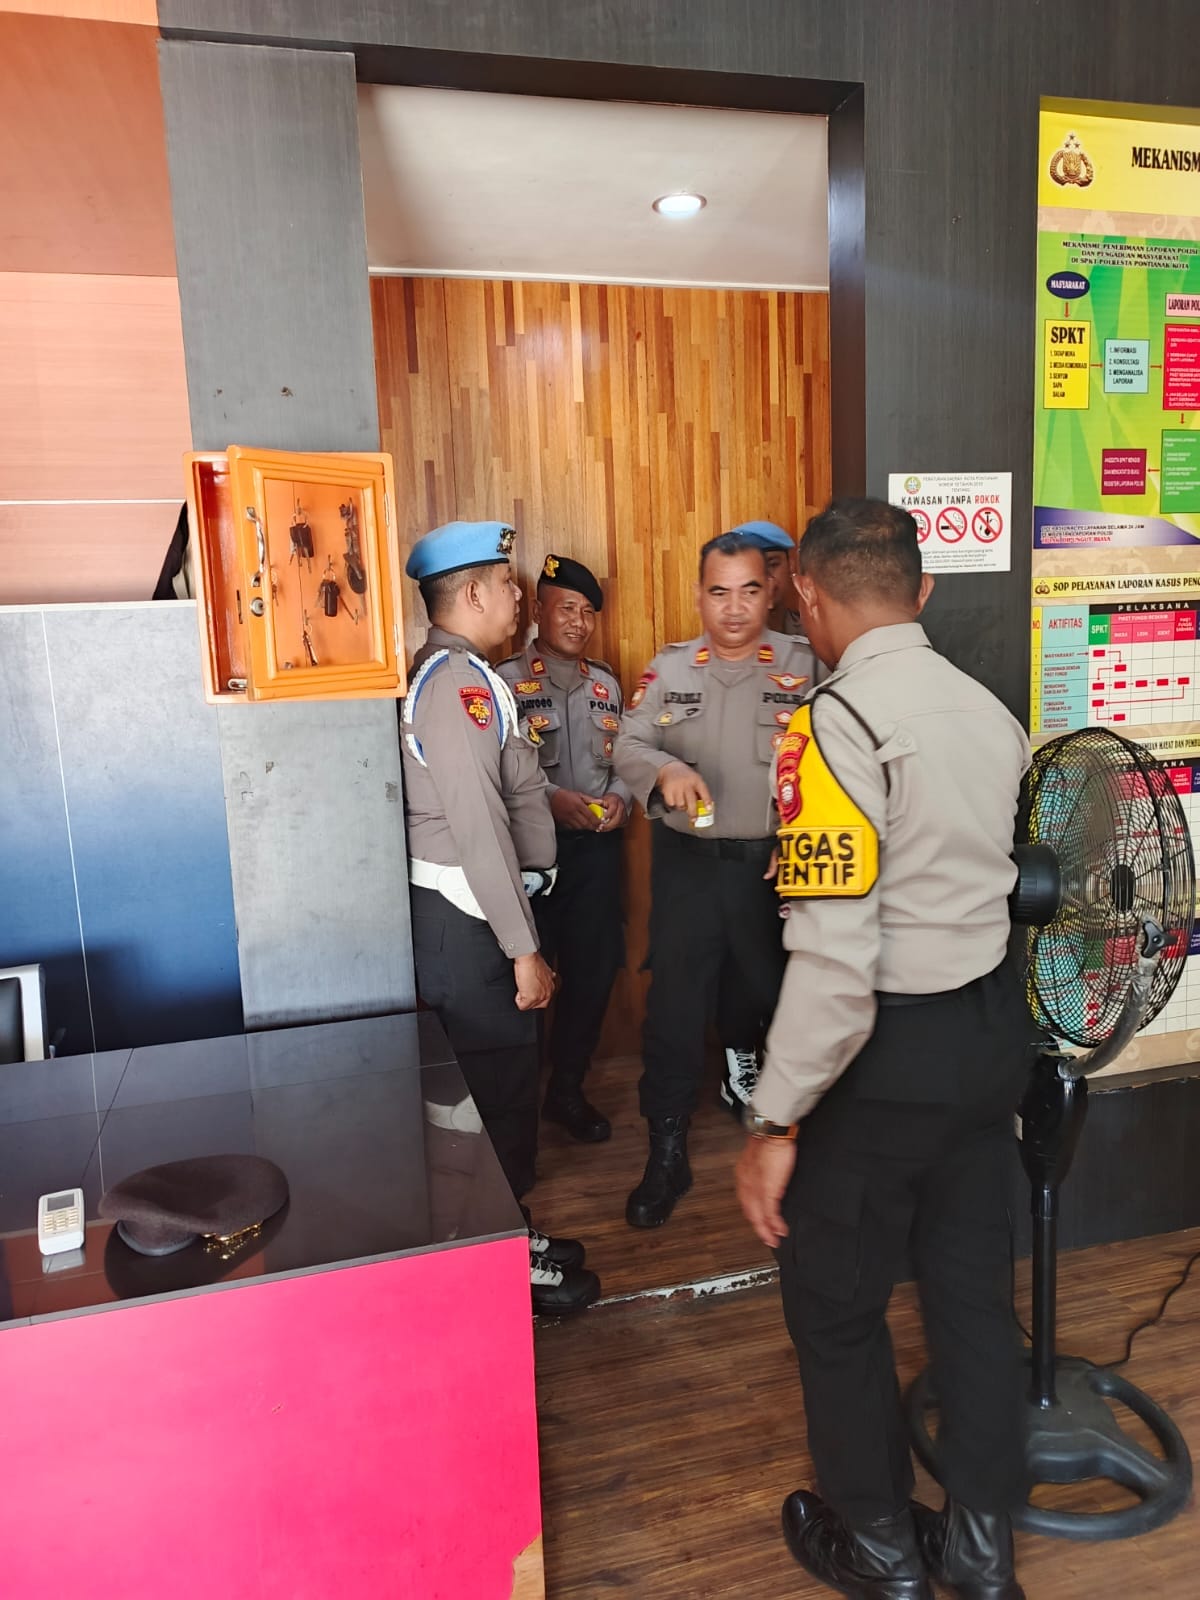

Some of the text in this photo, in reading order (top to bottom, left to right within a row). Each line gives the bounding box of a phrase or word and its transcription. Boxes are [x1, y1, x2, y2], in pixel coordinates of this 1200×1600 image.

[1050, 280, 1086, 290] MASYARAKAT
[1050, 326, 1085, 344] SPKT
[901, 494, 1000, 505] KAWASAN TANPA ROKOK
[1053, 581, 1069, 591] SOP
[1071, 580, 1115, 591] PELAYANAN
[1117, 578, 1153, 589] LAPORAN
[1155, 577, 1181, 587] KASUS
[1118, 602, 1189, 611] PELAKSANA
[1048, 617, 1083, 629] AKTIFITAS
[1091, 624, 1108, 634] SPKT
